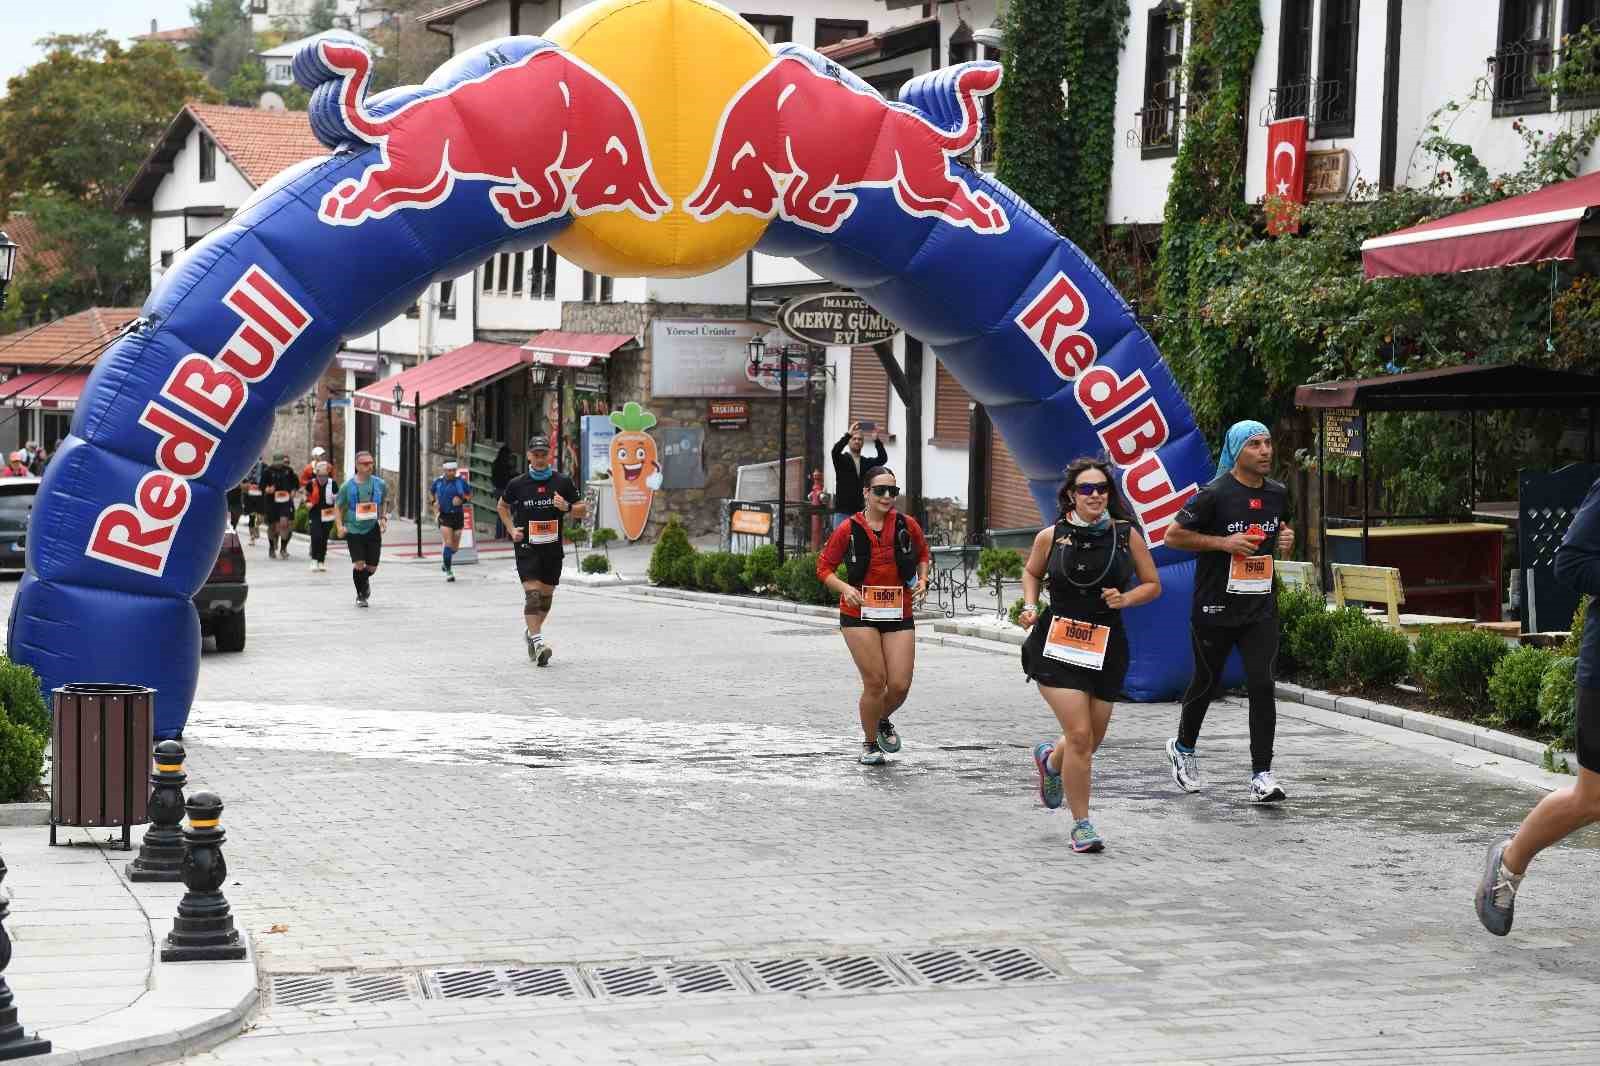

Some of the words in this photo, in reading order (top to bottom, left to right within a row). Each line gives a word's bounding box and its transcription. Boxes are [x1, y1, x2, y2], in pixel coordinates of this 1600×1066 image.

[793, 312, 843, 328] MERVE
[666, 327, 698, 336] Yöresel
[702, 325, 736, 336] Ürünler
[1065, 626, 1093, 641] 19001
